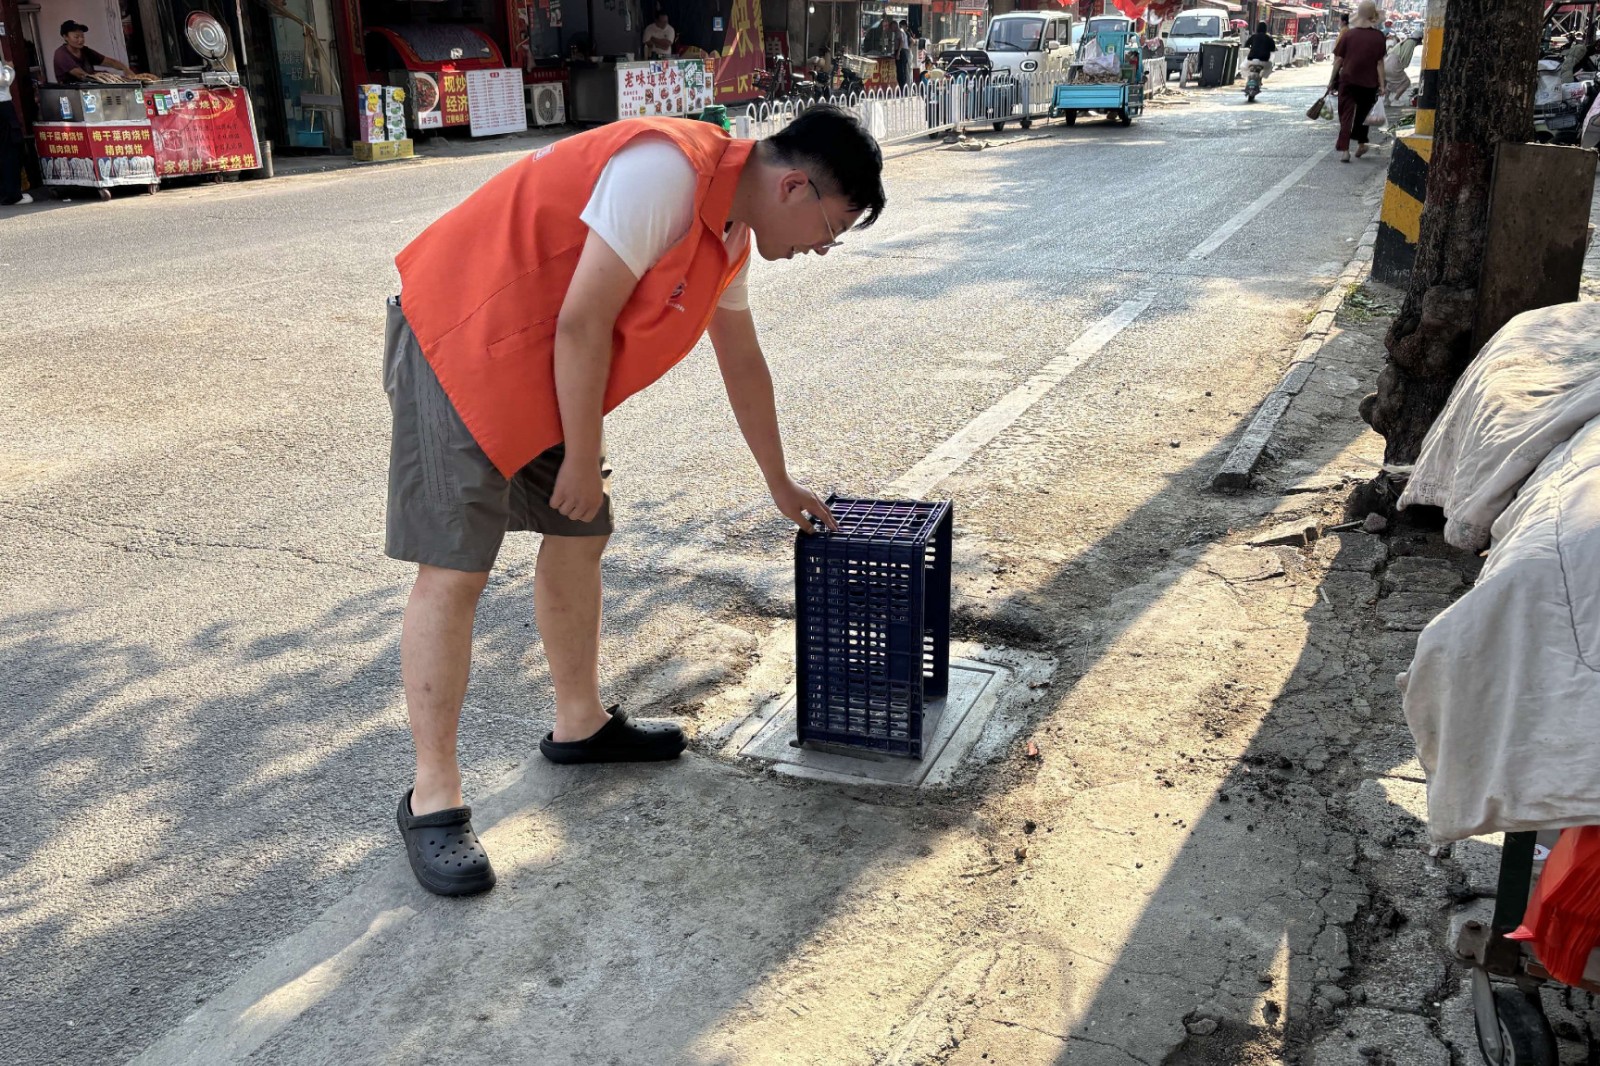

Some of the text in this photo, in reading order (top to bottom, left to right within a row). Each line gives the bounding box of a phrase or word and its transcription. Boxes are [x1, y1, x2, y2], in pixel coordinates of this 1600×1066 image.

[443, 75, 467, 92] 现炒
[39, 131, 84, 141] 梅干菜肉烧饼
[92, 129, 150, 142] 梅干菜肉烧饼
[49, 144, 79, 154] 精肉烧饼
[104, 144, 143, 156] 精肉烧饼
[157, 153, 255, 174] 家烧饼土家烧饼
